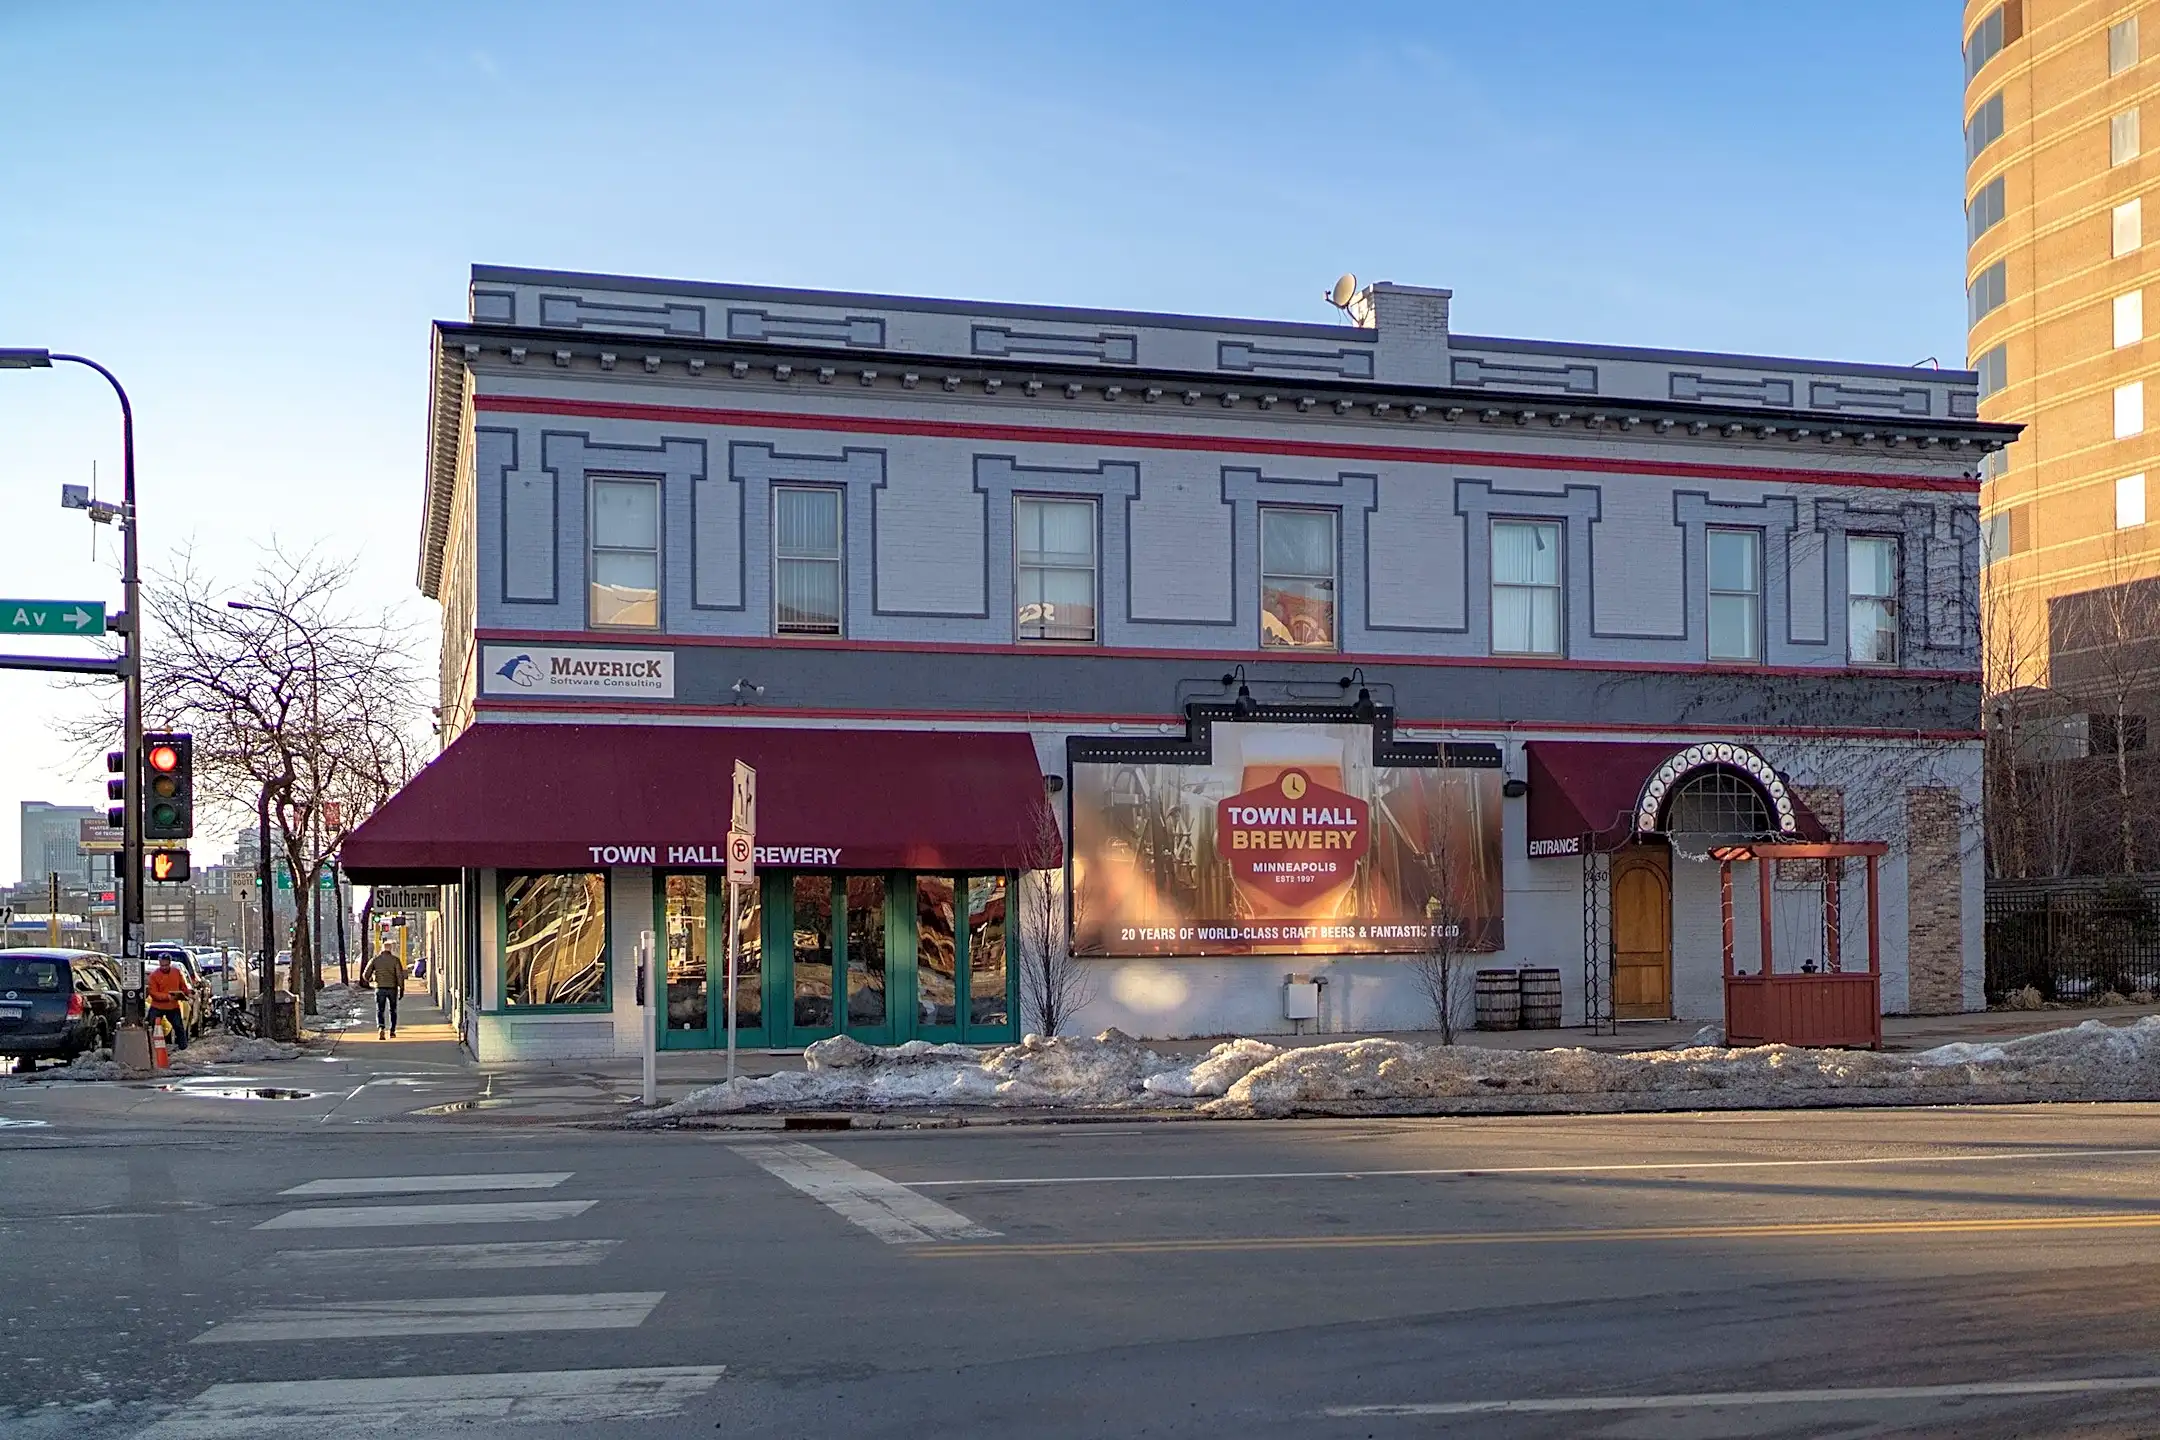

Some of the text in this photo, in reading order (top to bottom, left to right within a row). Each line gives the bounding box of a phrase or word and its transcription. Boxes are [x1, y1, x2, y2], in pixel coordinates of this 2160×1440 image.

[12, 607, 47, 626] Av
[550, 657, 662, 678] MAVERICK
[550, 677, 662, 689] Software Consulting
[1228, 807, 1357, 825] TOWN HALL
[1232, 830, 1357, 849] BREWERY
[1529, 838, 1579, 856] ENTRANCE
[588, 846, 842, 865] TOWN HALL REWERY
[1253, 862, 1336, 872] MINNEAPOLIS
[1297, 875, 1315, 883] 1997
[376, 889, 431, 908] Southern
[1121, 925, 1459, 941] 20 YEARS OF WORLD-CLASS CRAFT BEERS & FANTASTIC FOOD
